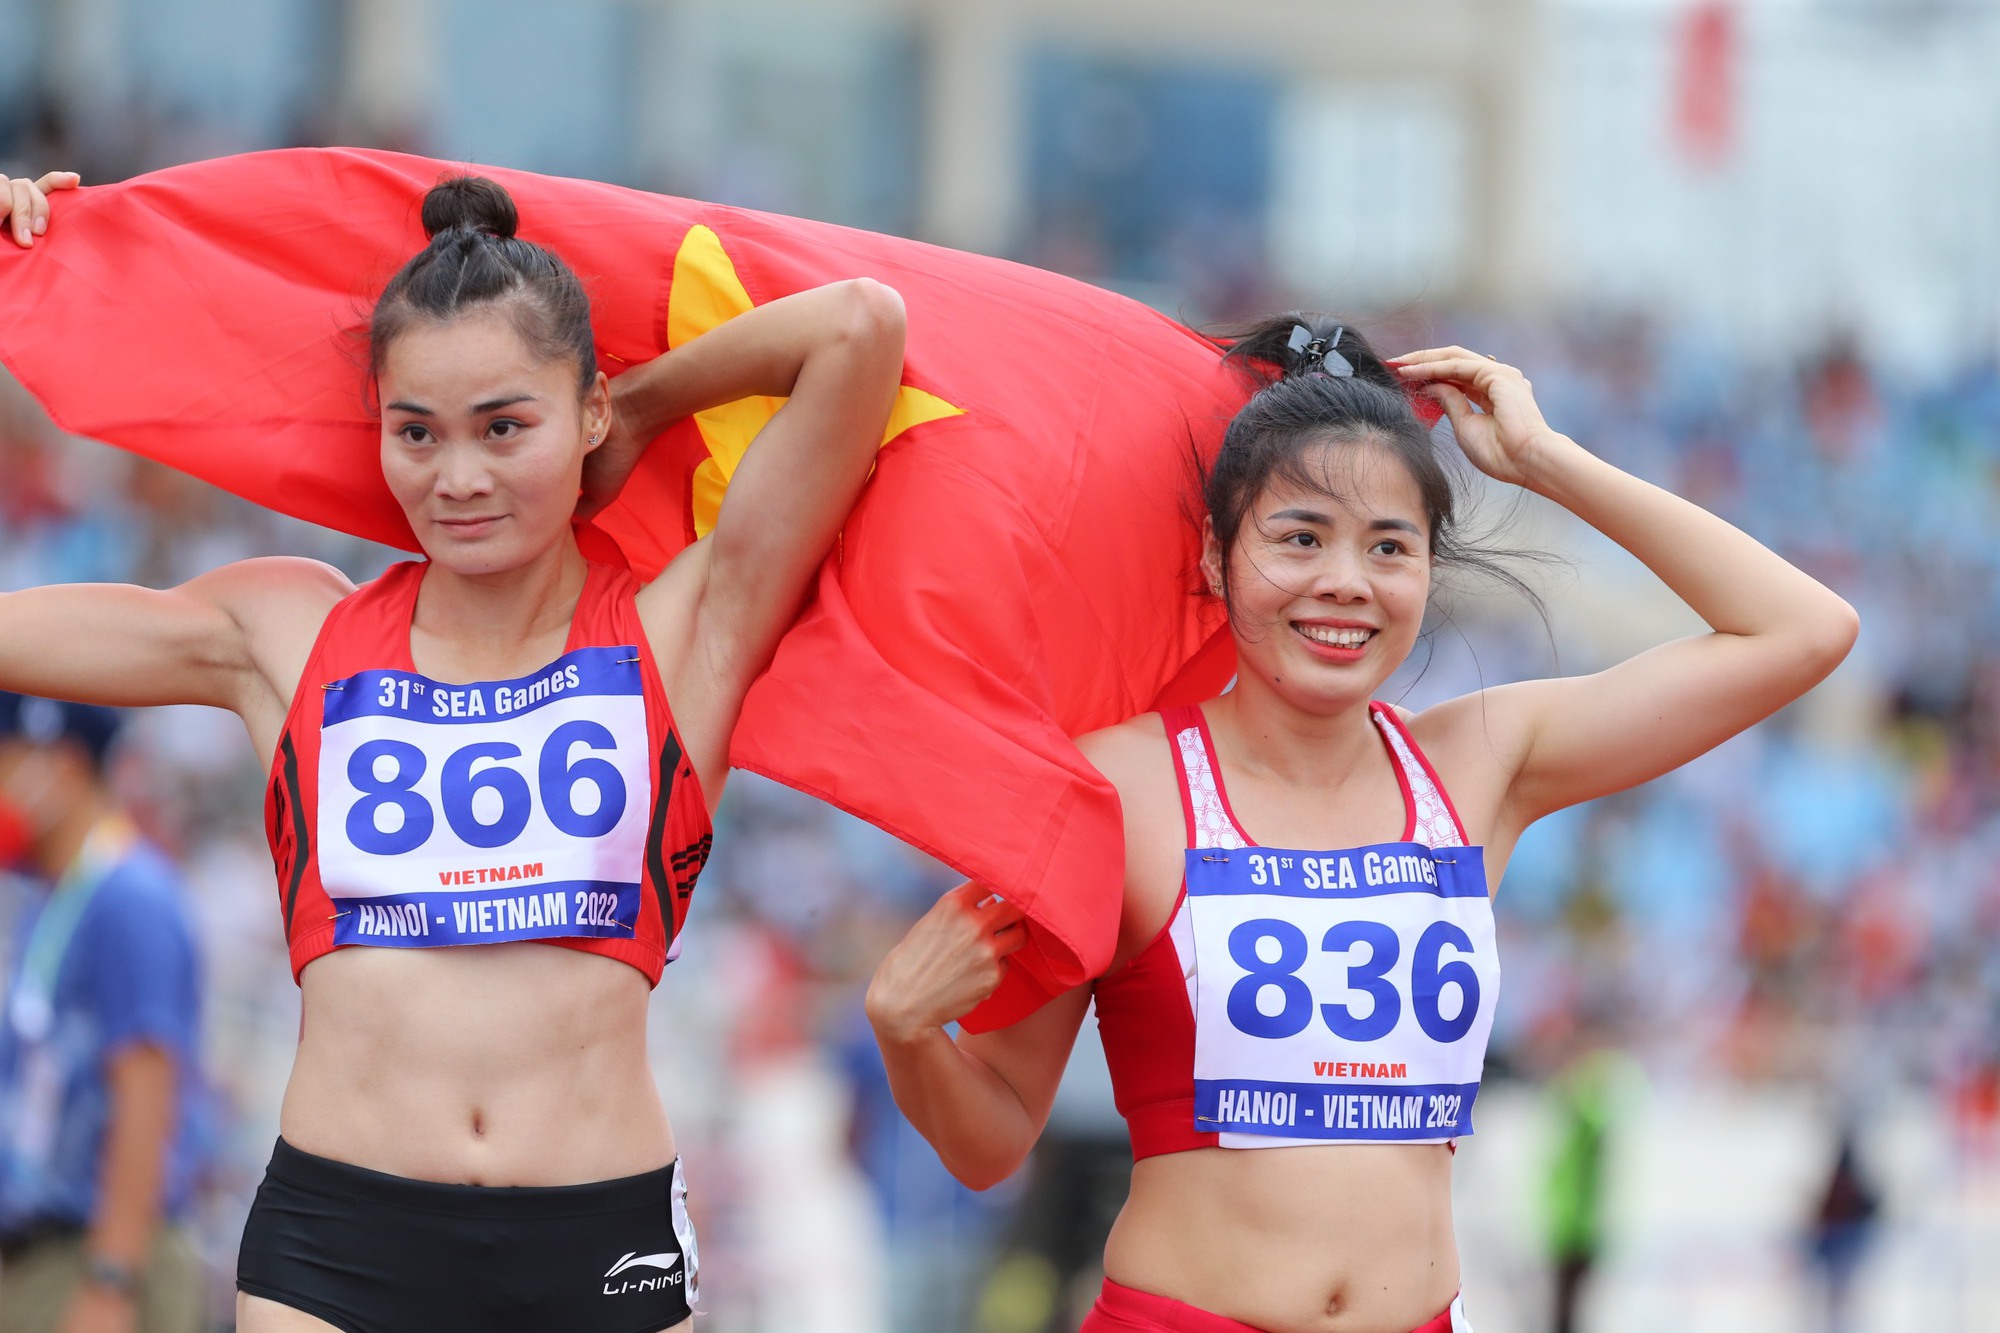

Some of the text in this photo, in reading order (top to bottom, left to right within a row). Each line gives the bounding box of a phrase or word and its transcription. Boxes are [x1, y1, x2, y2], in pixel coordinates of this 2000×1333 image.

[432, 688, 487, 717] SEA
[494, 664, 580, 715] Games
[345, 720, 627, 856] 866
[438, 862, 544, 886] VIETNAM
[1303, 857, 1358, 890] SEA
[1363, 852, 1438, 887] Games
[358, 902, 430, 937] HANOI
[453, 891, 568, 934] VIETNAM
[575, 891, 618, 927] 2022
[1227, 918, 1481, 1044] 836
[1313, 1061, 1407, 1078] VIETNAM
[1217, 1089, 1297, 1127] HANOI
[1323, 1094, 1422, 1129] VIETNAM
[1426, 1094, 1462, 1128] 2022
[603, 1270, 683, 1295] LI-NING
